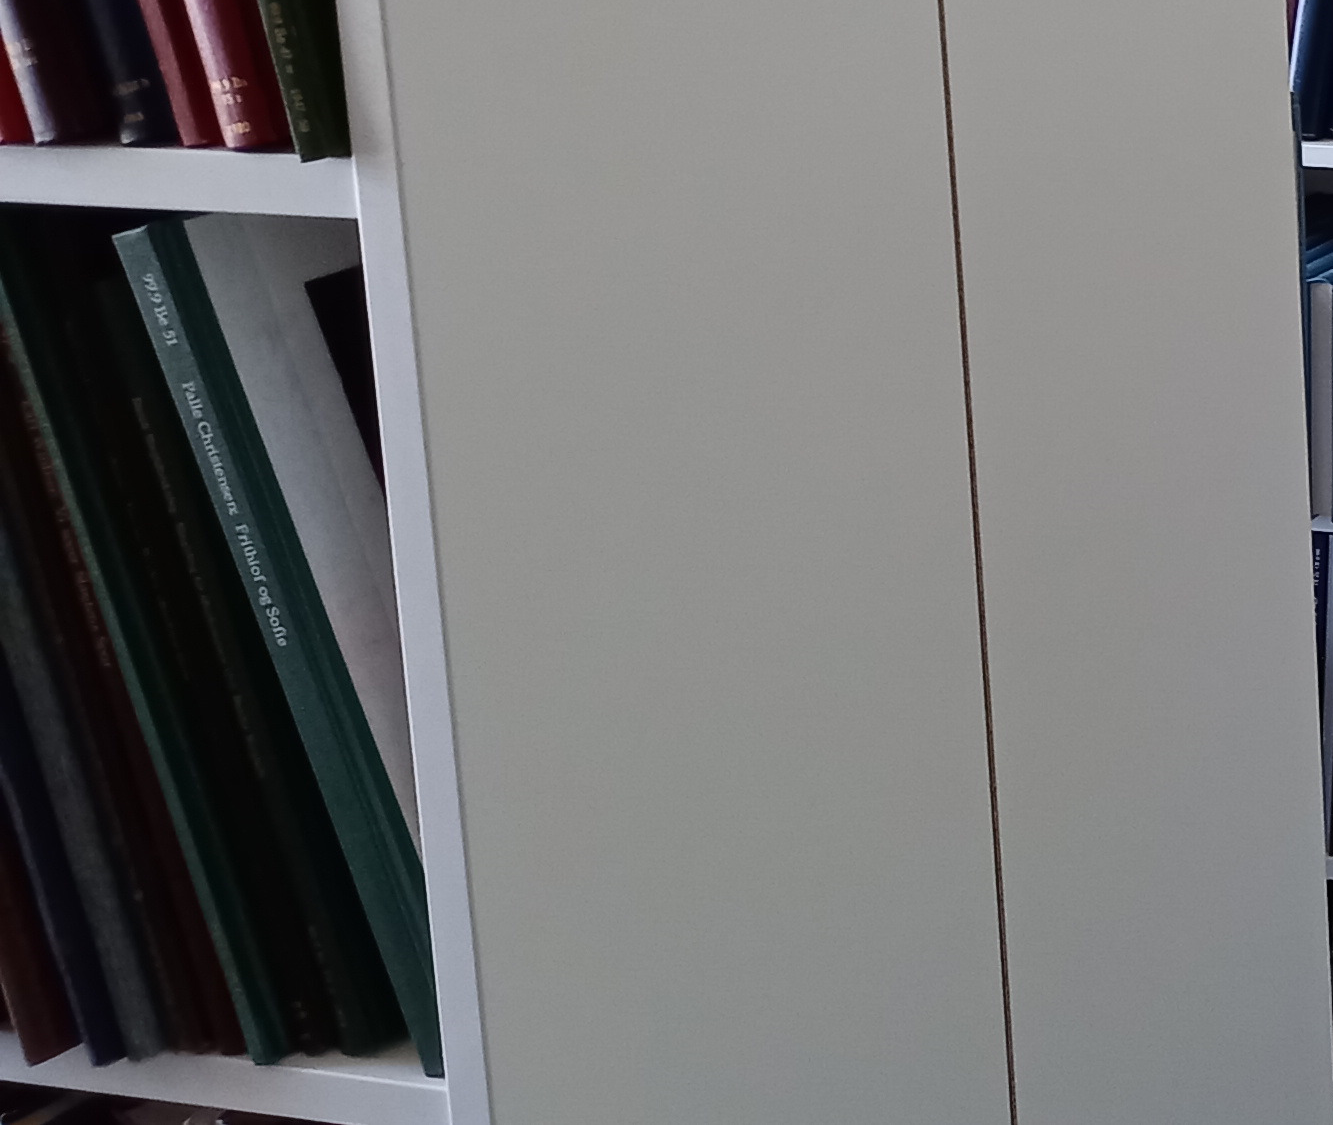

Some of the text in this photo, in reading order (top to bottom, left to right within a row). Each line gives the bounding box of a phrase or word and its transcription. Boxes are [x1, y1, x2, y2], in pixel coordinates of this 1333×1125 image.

[162, 329, 178, 346] 51
[182, 380, 203, 419] Palle
[258, 586, 272, 606] og
[266, 606, 287, 647] Sofie
